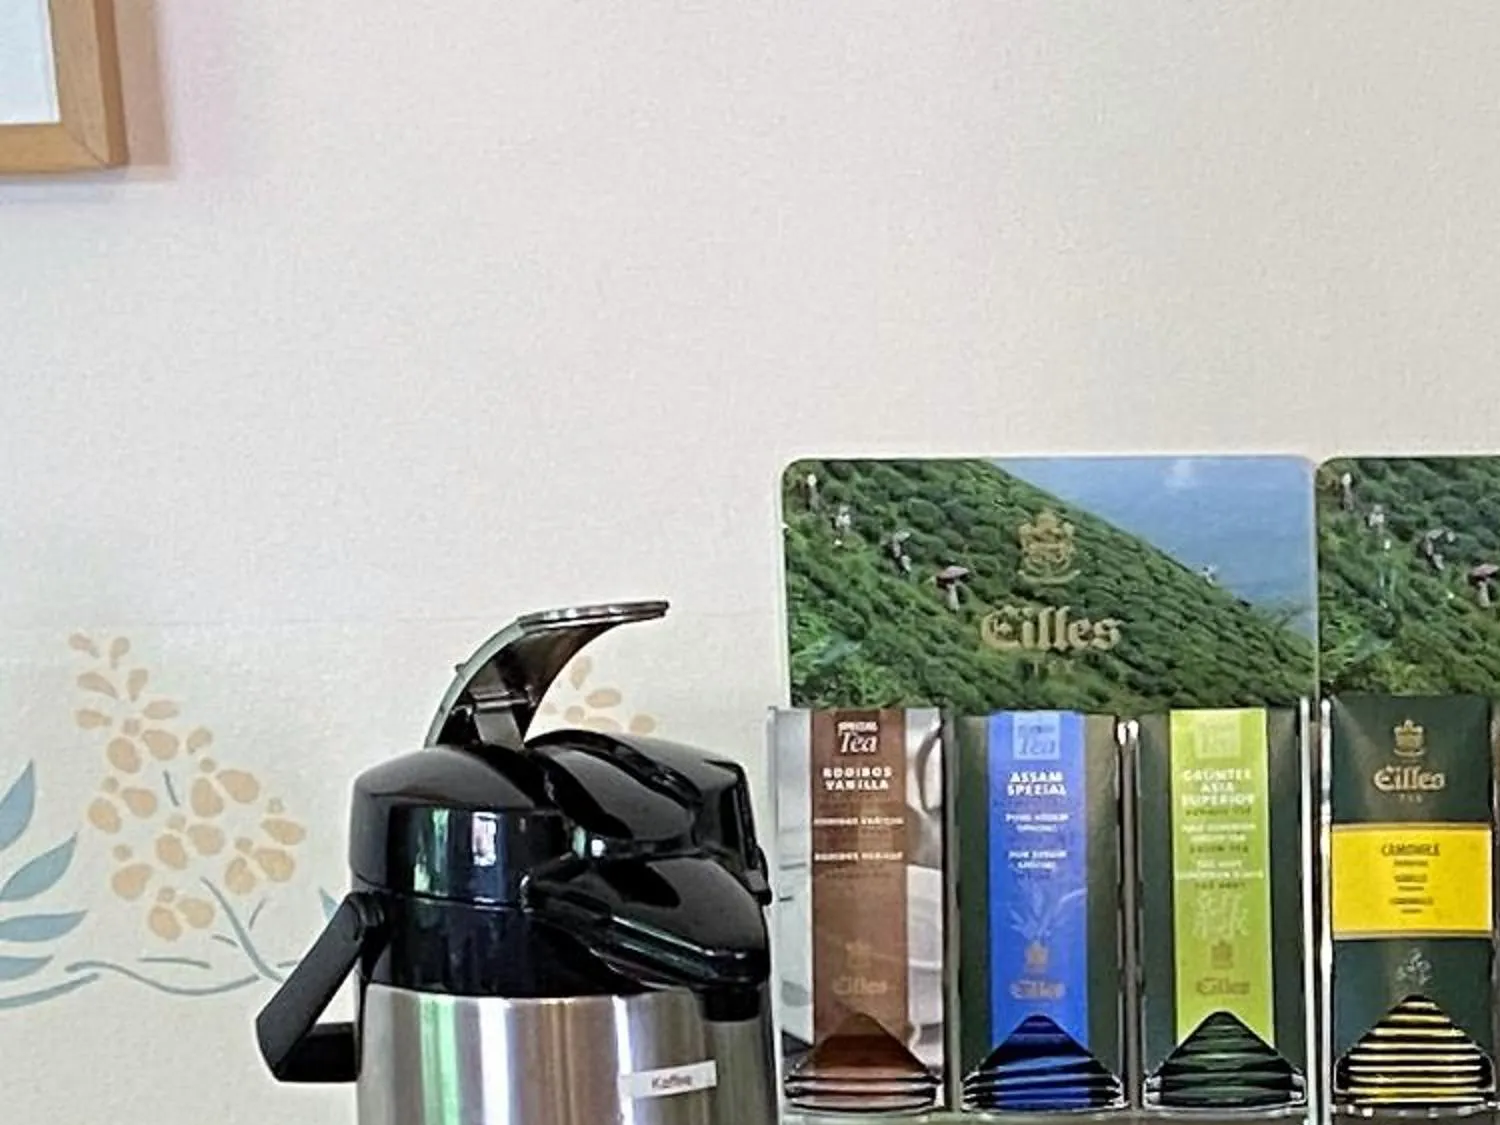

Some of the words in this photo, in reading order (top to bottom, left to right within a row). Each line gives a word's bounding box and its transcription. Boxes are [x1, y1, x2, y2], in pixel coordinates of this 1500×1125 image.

[981, 604, 1125, 650] Eilles
[838, 730, 879, 753] Tea
[825, 779, 889, 791] VANILLA
[1374, 764, 1446, 791] Eilles
